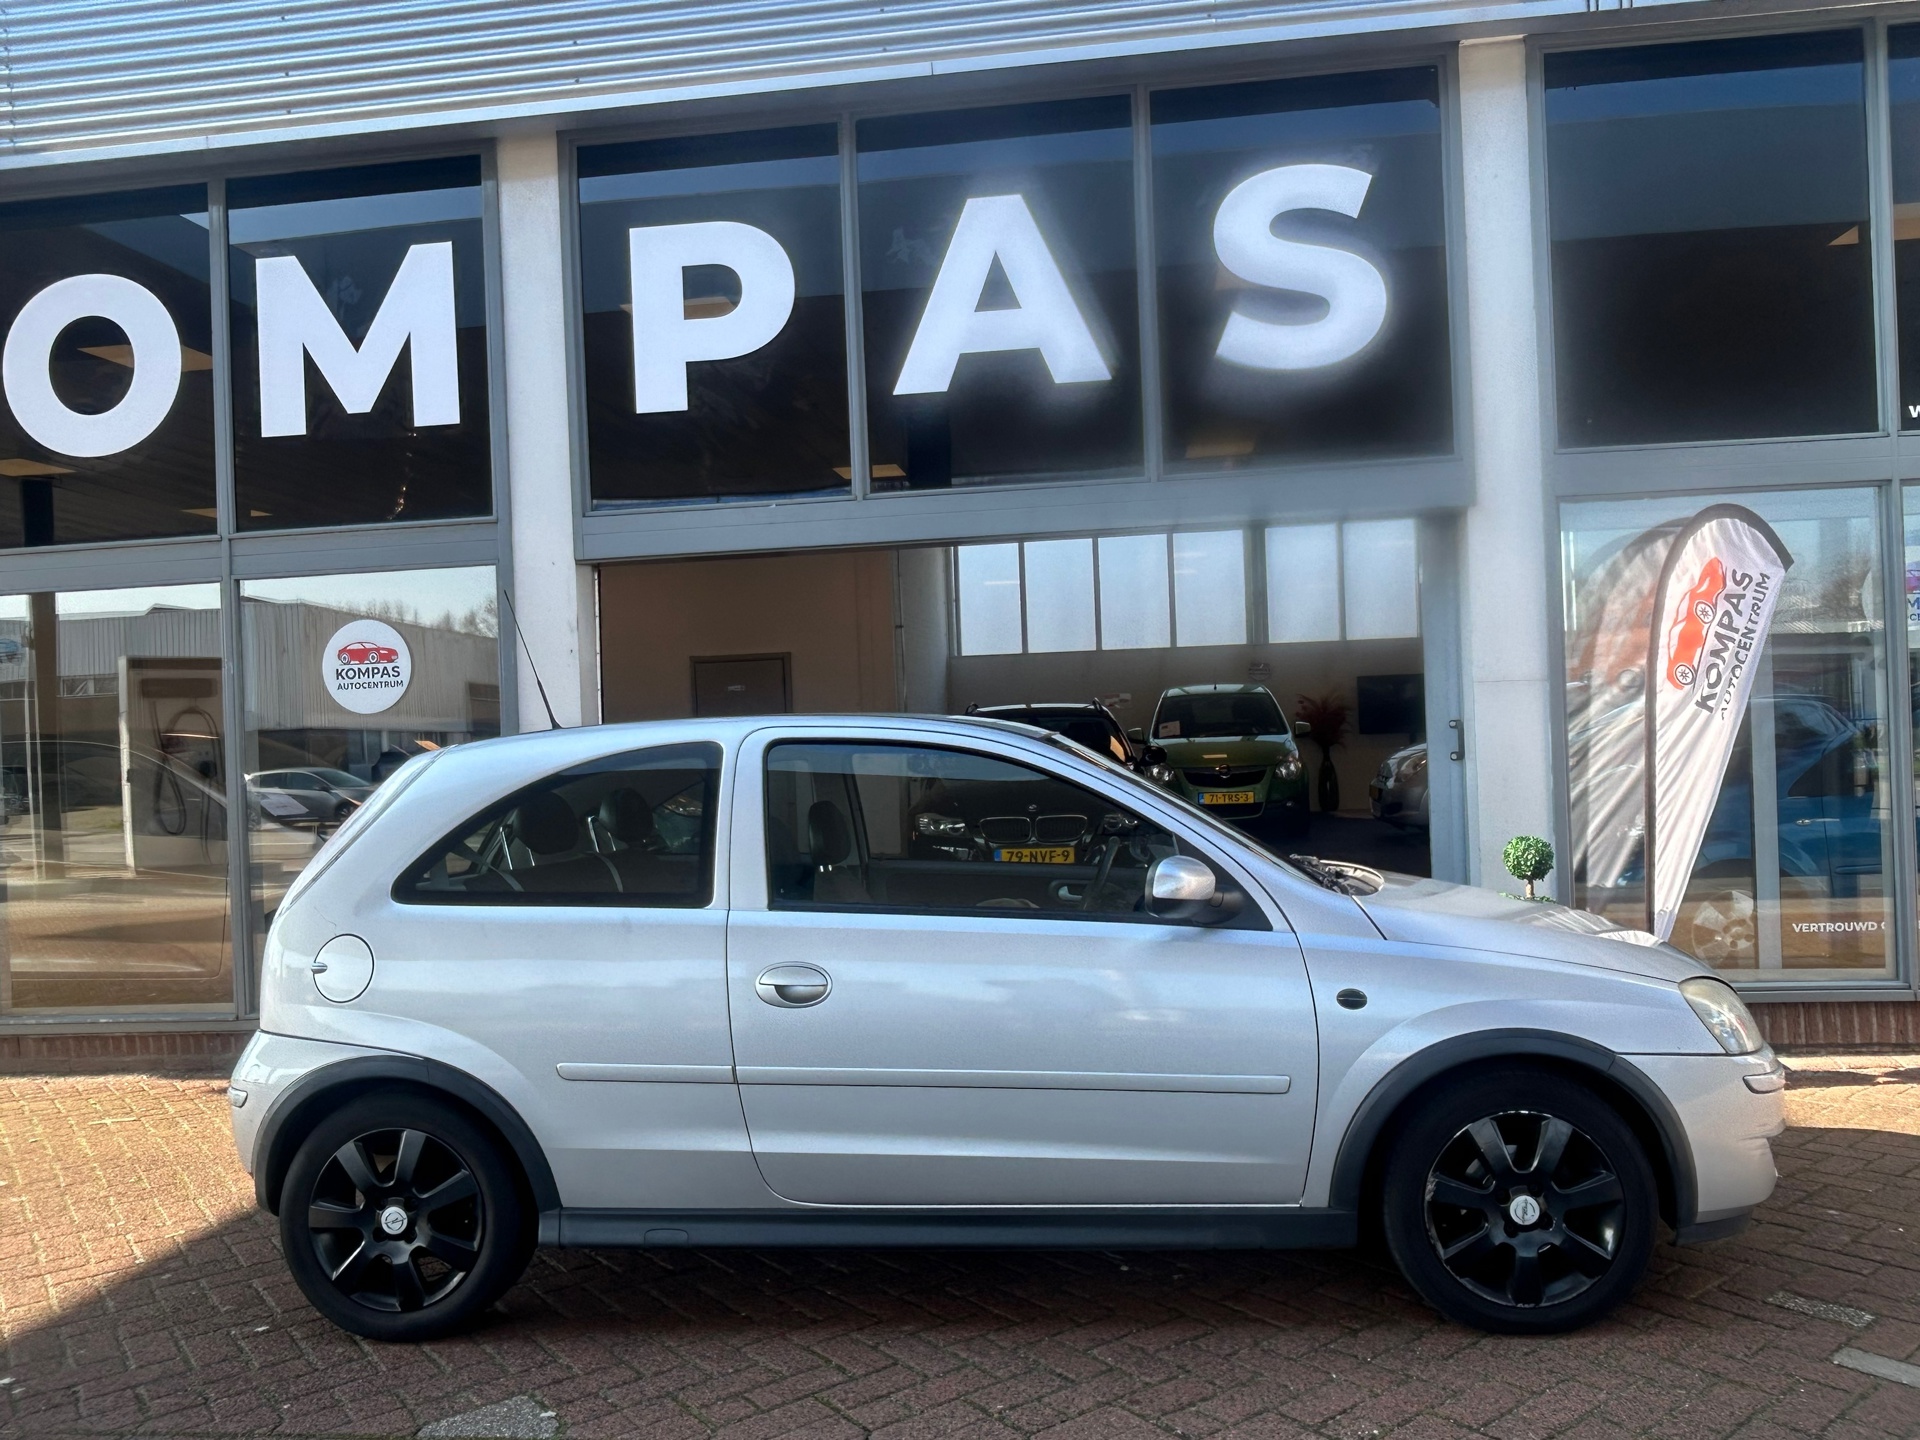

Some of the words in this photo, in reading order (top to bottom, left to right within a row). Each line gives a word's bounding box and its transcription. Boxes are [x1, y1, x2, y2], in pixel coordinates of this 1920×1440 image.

[1695, 569, 1754, 714] KOMPAS
[336, 666, 401, 680] KOMPAS
[337, 680, 404, 691] AUTOCENTRUM
[1007, 848, 1071, 863] 79-NVF-9
[1792, 921, 1878, 933] VERTROUWD
